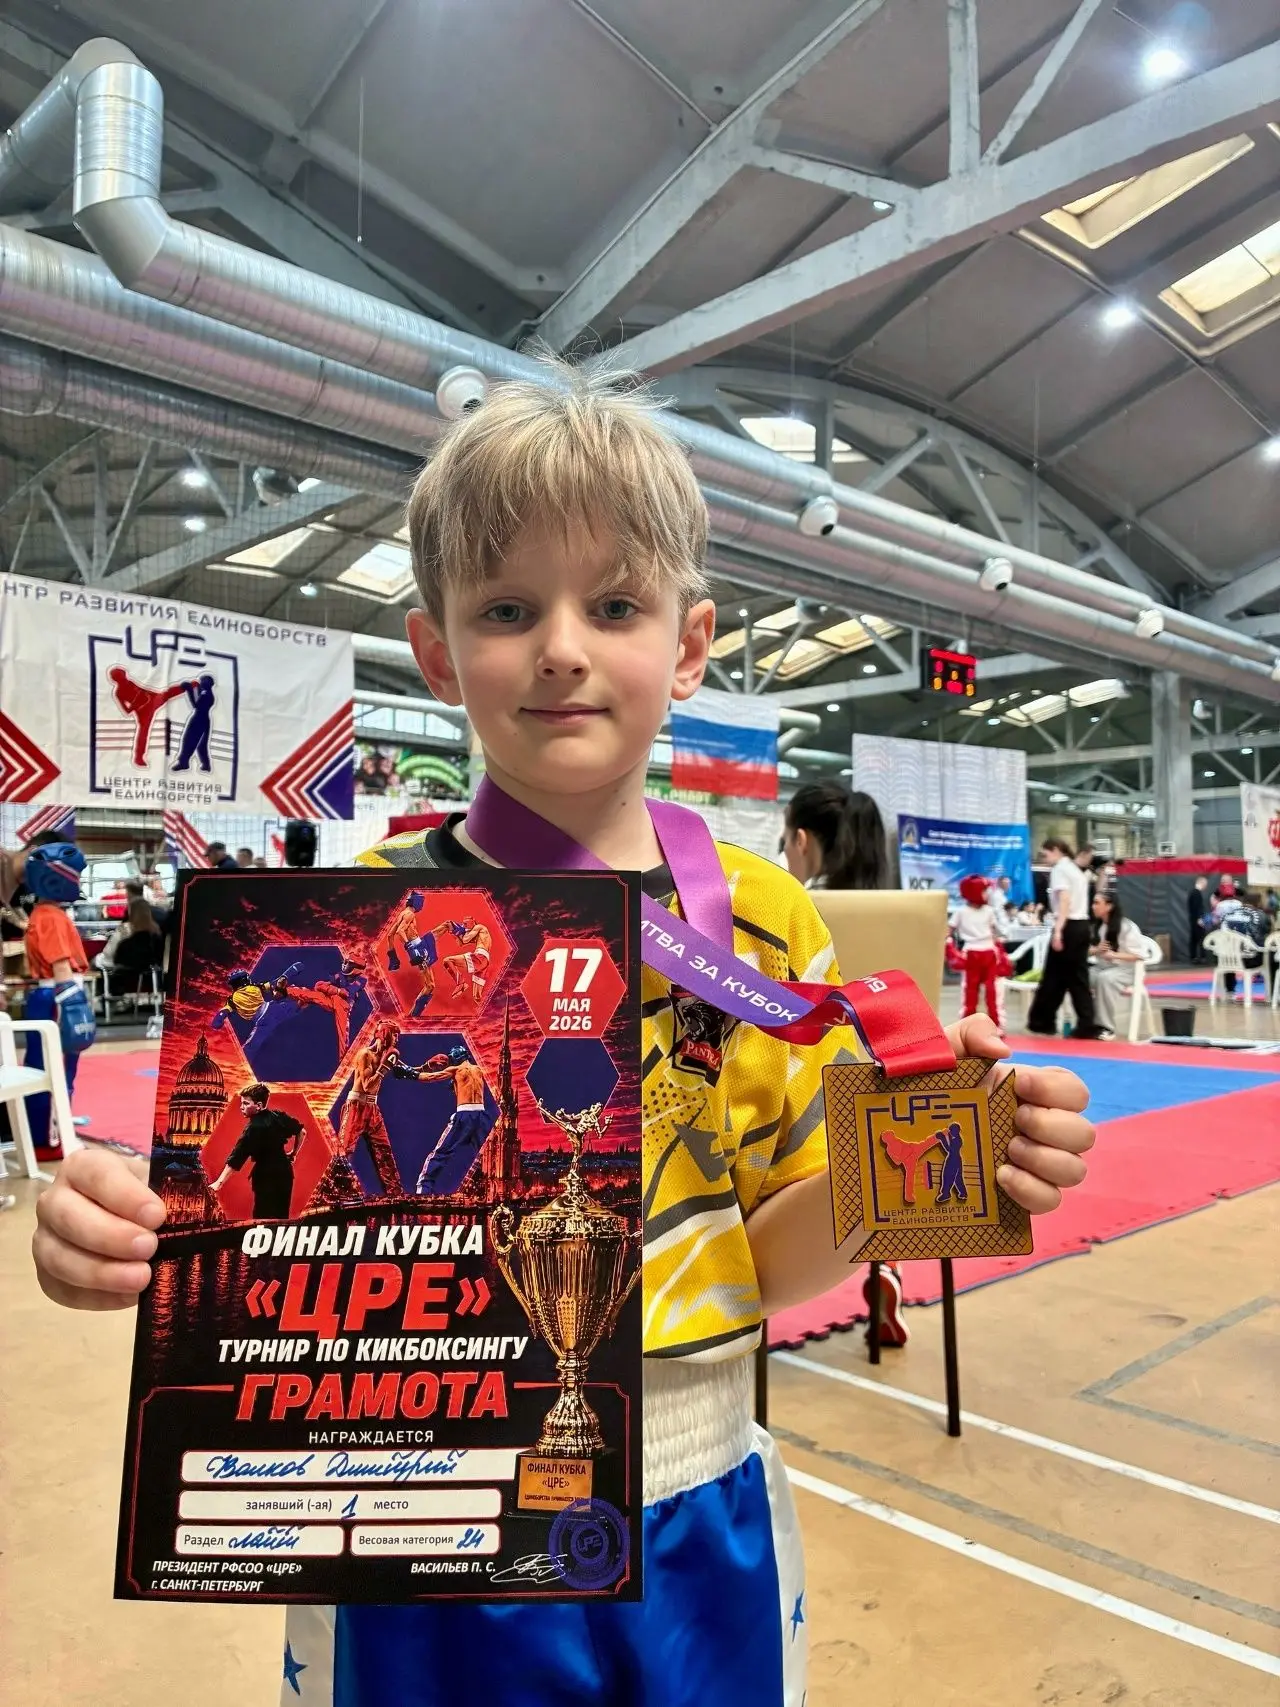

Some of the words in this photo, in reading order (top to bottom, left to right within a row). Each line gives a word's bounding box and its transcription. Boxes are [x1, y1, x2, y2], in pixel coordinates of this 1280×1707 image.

[60, 590, 178, 619] РАЗВИТИЯ
[188, 610, 327, 646] ЕДИНОБОРСТВ
[103, 776, 151, 787] ЦЕНТР
[545, 948, 603, 993] 17
[688, 955, 719, 981] ЗА
[721, 976, 799, 1022] КУБОК
[553, 998, 591, 1012] МАЯ
[549, 1016, 592, 1030] 2026
[884, 1209, 917, 1217] ЦЕНТР
[921, 1206, 976, 1215] РАЗВИТИЯ
[893, 1215, 969, 1225] ЕДИНОБОРСТВ
[241, 1225, 364, 1258] ФИНАЛ
[375, 1225, 483, 1255] КУБКА
[245, 1262, 492, 1342] «ЦРЕ»
[218, 1339, 310, 1363] ТУРНИР
[316, 1338, 349, 1362] ПО
[355, 1336, 529, 1362] КИКБОКСИНГУ
[236, 1371, 508, 1421] ГРАМОТА
[309, 1430, 433, 1445] НАГРАЖДАЕТСЯ
[527, 1463, 557, 1474] ФИНАЛ
[559, 1464, 586, 1475] КУБКА
[542, 1476, 570, 1489] «ЦРЕ»
[245, 1496, 305, 1511] занявший
[307, 1498, 332, 1514] (-ая)
[341, 1494, 359, 1520] 1
[373, 1500, 409, 1510] место
[184, 1534, 224, 1547] Раздел
[359, 1535, 400, 1545] Весовая
[402, 1535, 454, 1547] категория
[456, 1528, 485, 1549] 24
[152, 1560, 219, 1574] ПРЕЗИДЕНТ
[221, 1561, 263, 1574] РФСОО
[266, 1562, 302, 1576] «ЦРЕ»
[410, 1562, 468, 1574] ВАСИЛЬЕВ
[470, 1562, 483, 1573] П.
[485, 1562, 496, 1573] С.
[151, 1581, 158, 1590] г.
[160, 1578, 264, 1592] САНКТ-ПЕТЕРБУРГ
